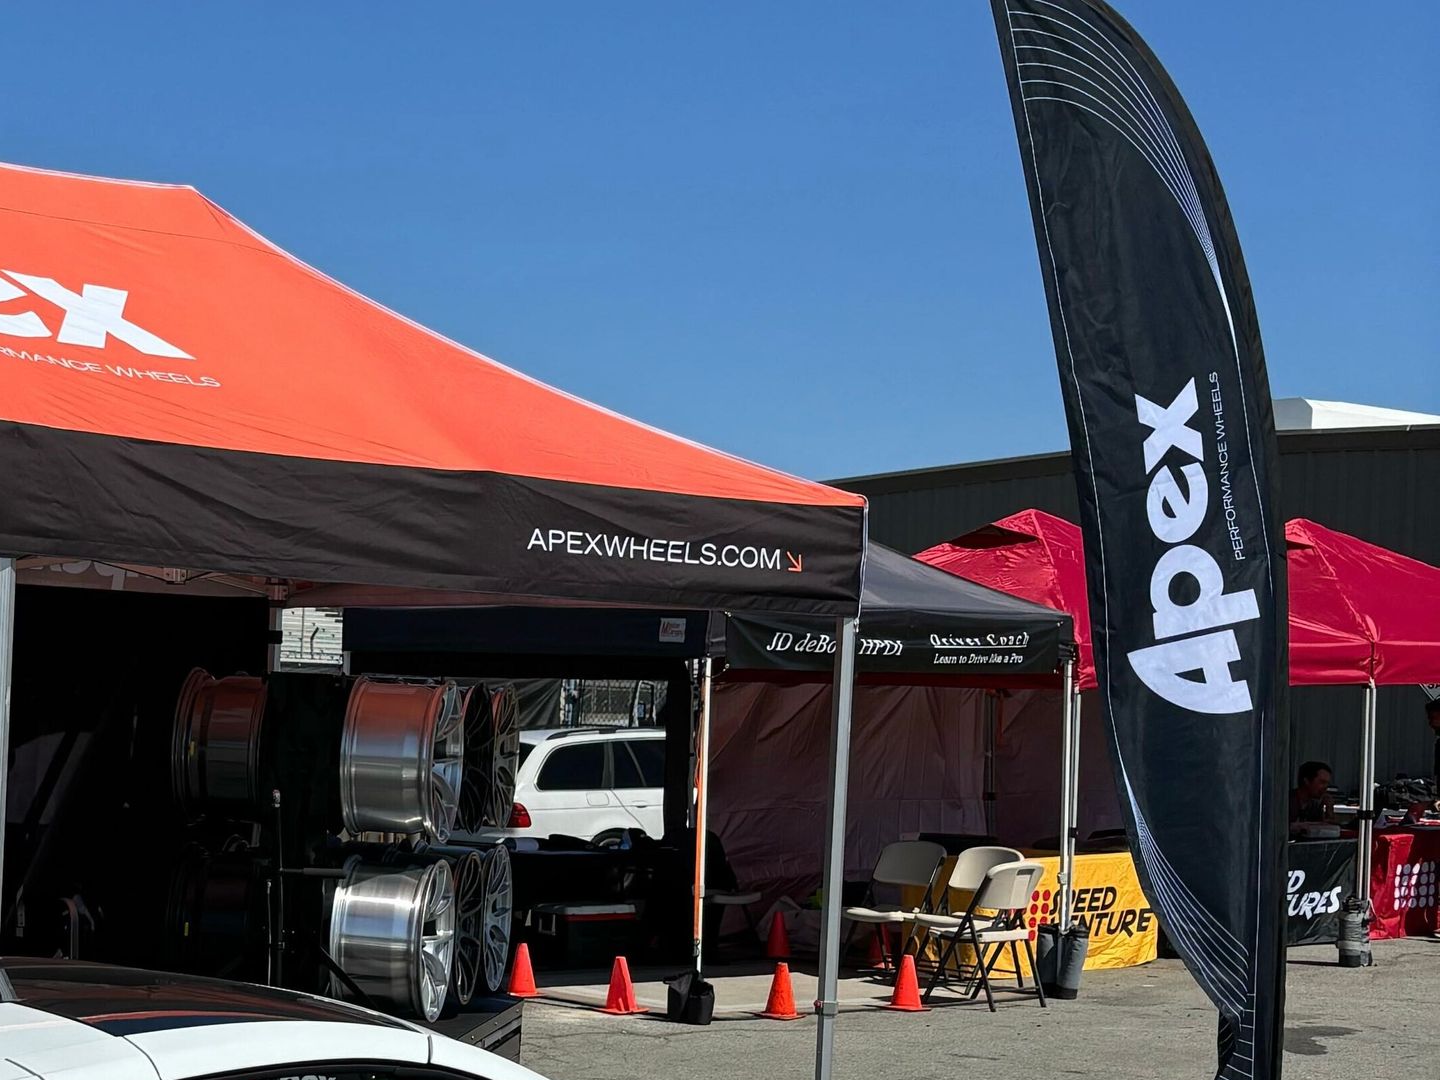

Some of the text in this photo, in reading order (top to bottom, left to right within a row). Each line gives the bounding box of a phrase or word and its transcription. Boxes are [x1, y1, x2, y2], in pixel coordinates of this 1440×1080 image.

[105, 364, 221, 388] WHEELS
[1209, 371, 1246, 561] PERFORMANCE WHEELS
[526, 527, 781, 570] APEXWHEELS.COM
[1126, 376, 1260, 715] Apex
[766, 632, 793, 651] JD
[934, 653, 957, 664] Learn
[959, 654, 967, 664] to
[968, 653, 988, 664] Drive
[1010, 653, 1023, 663] Pro
